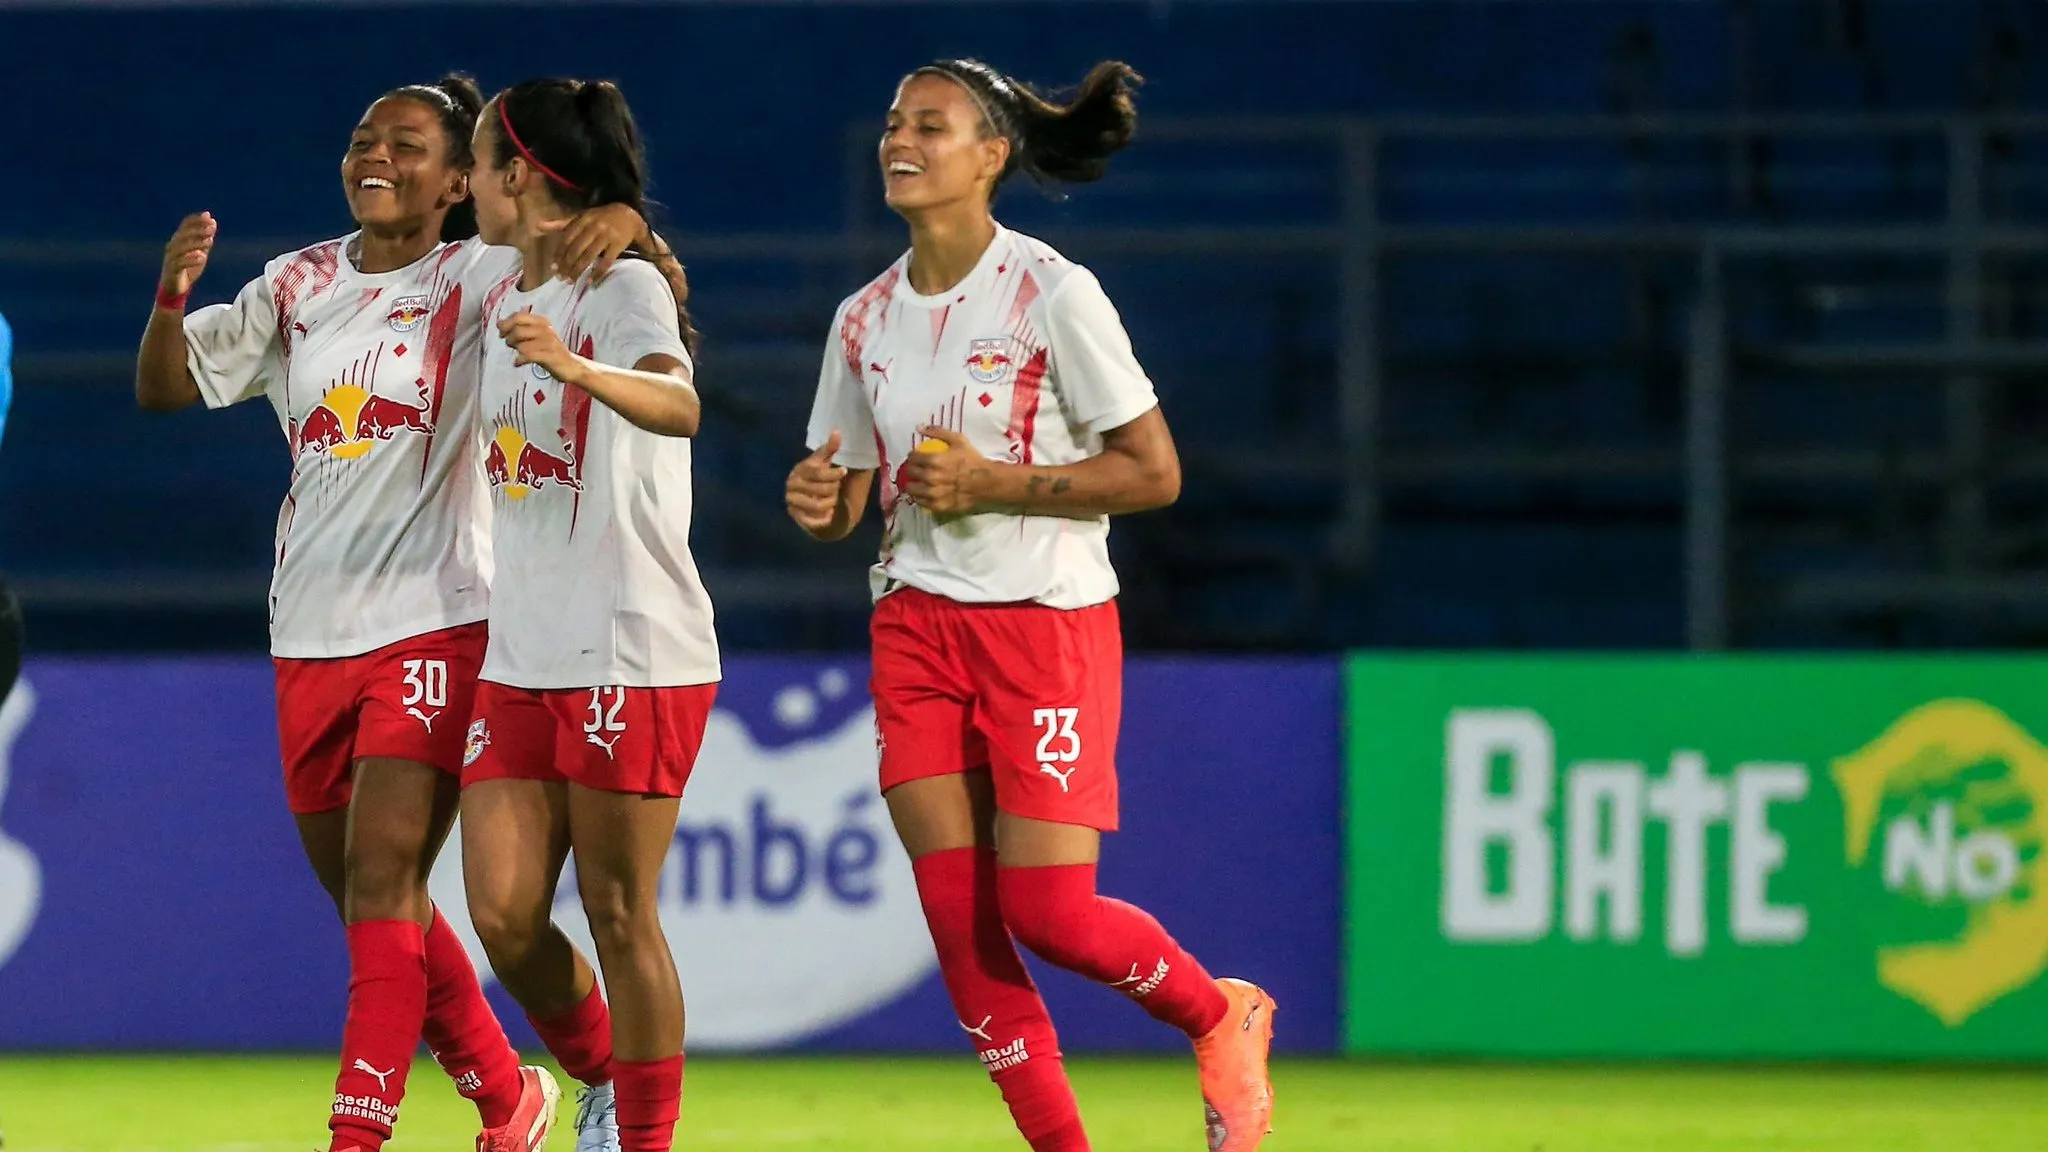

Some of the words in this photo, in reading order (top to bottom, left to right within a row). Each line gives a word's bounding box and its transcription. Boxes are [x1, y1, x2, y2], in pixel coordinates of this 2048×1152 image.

[402, 659, 447, 707] 30
[583, 686, 627, 733] 32
[1033, 707, 1081, 763] 23
